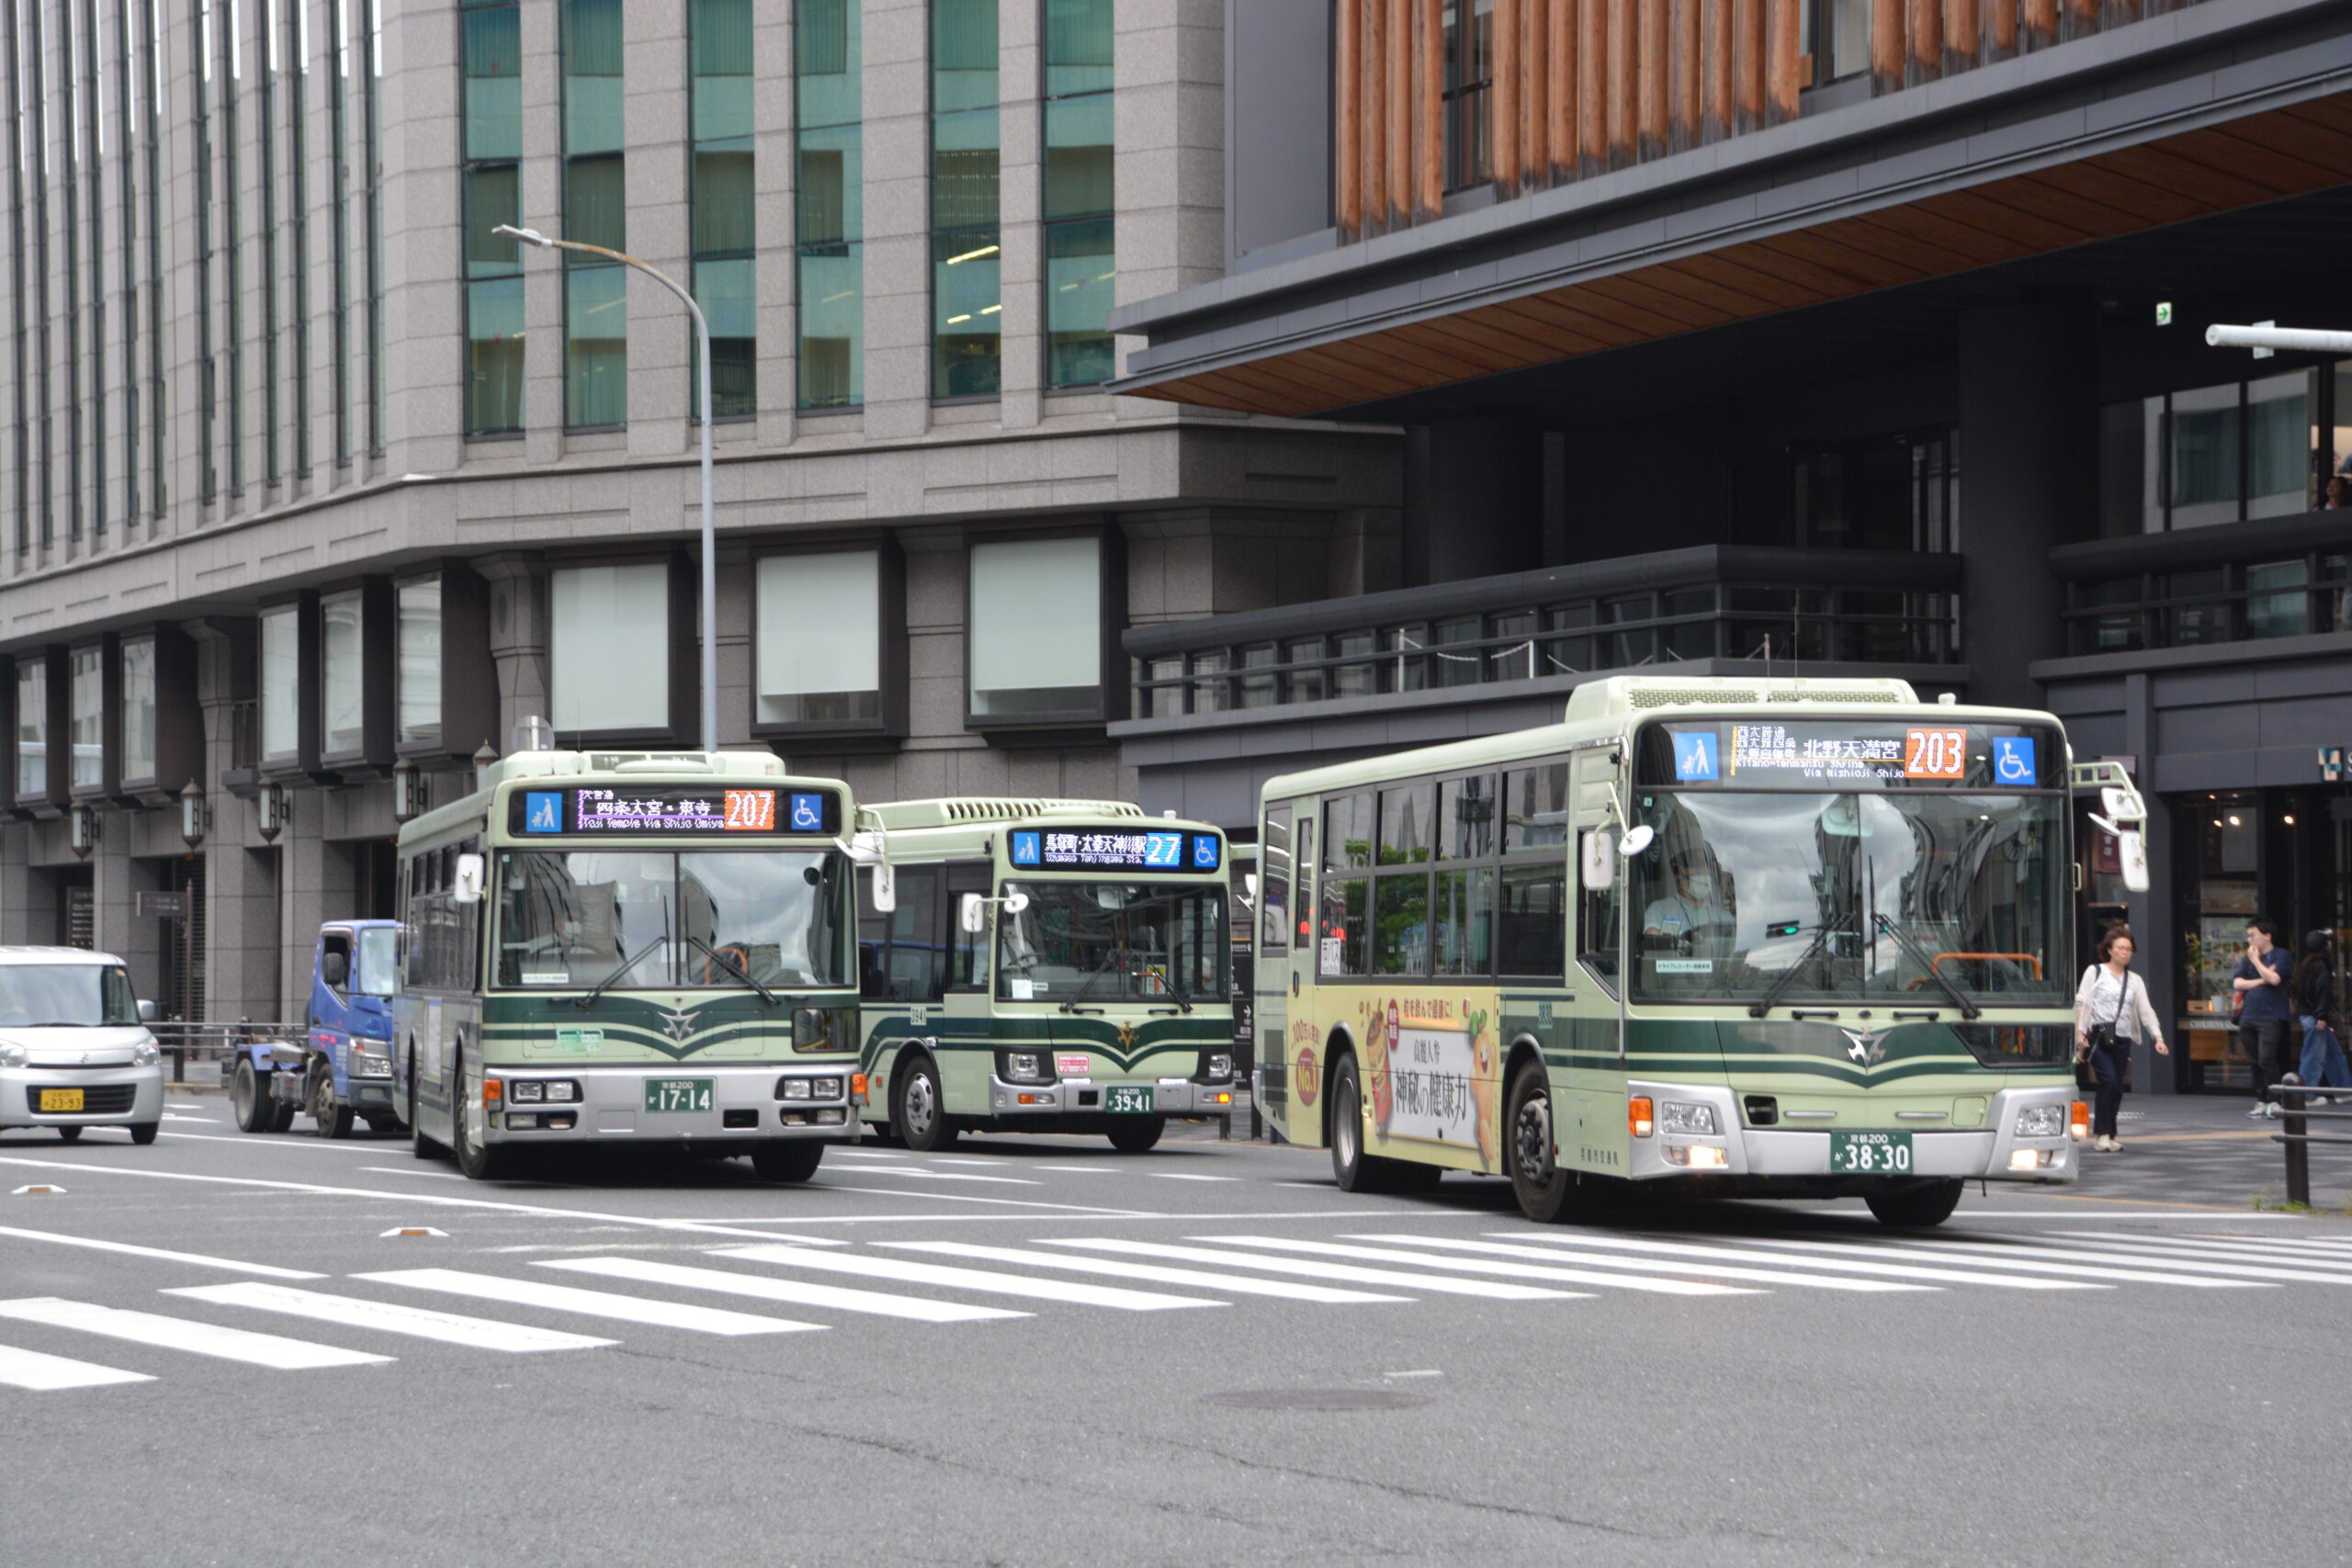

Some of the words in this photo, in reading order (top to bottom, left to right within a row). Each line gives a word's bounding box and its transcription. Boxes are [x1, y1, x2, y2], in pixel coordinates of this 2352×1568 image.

[1736, 726, 1785, 738] 西大路通
[1736, 738, 1796, 749] 西大路四条
[1803, 739, 1901, 760] 北野天満宮
[1907, 731, 1963, 774] 203
[1804, 769, 1822, 778] Via
[1826, 769, 1871, 778] Nishioji
[1876, 769, 1905, 779] Shijo
[595, 798, 711, 817] 四条大宮・東寺
[727, 791, 774, 828] 207
[607, 818, 641, 829] Temple
[644, 818, 661, 829] Via
[663, 818, 693, 829] Shijo
[1147, 836, 1180, 863] 27
[911, 1008, 926, 1023] 3941
[1297, 1056, 1317, 1092] No.1
[660, 1089, 710, 1110] 17-14
[1114, 1094, 1150, 1111] 39-41
[1394, 1067, 1468, 1131] 神秘の健康力
[1845, 1144, 1909, 1170] 38-30
